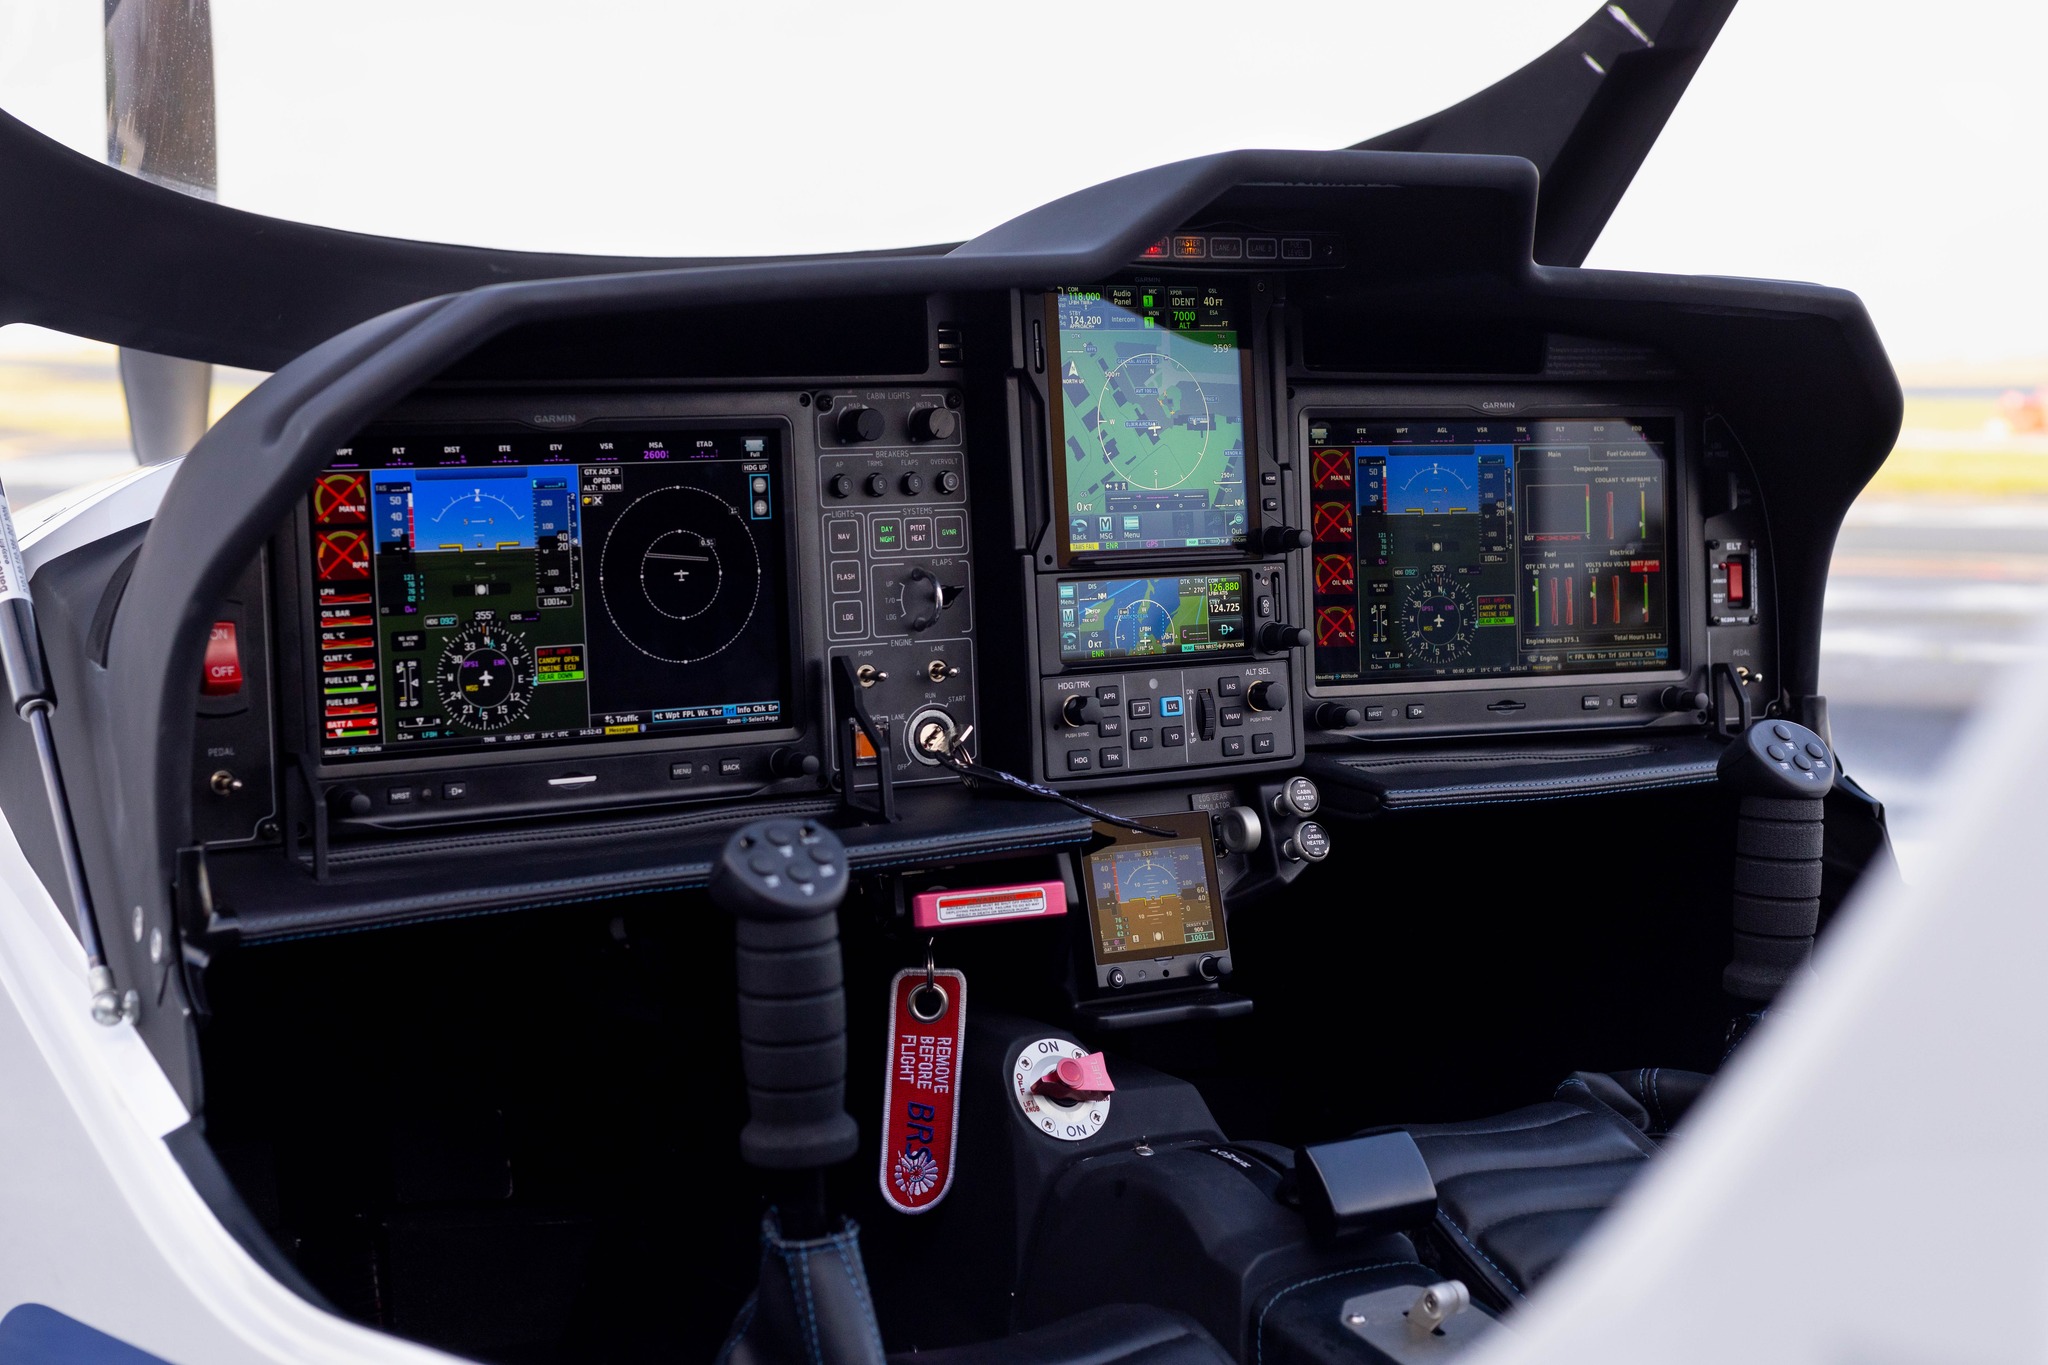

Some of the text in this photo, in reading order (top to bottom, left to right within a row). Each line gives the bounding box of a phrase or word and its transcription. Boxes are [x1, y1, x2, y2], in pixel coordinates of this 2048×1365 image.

[1172, 298, 1195, 306] IDENT
[1070, 316, 1101, 325] 124.200
[1173, 312, 1195, 321] 7000
[534, 415, 576, 423] GARMIN
[389, 497, 401, 505] 50
[391, 513, 402, 521] 40
[1209, 582, 1239, 592] 126.880
[1210, 604, 1240, 613] 124.725
[211, 629, 227, 640] ON
[212, 666, 235, 678] OFF
[1058, 681, 1090, 690] HDG/TRK
[665, 712, 680, 720] Wpt
[737, 705, 751, 713] Info
[753, 704, 766, 712] Chk
[616, 714, 639, 723] Traffic
[208, 748, 234, 757] PEDAL
[1038, 1041, 1059, 1053] ON
[900, 1034, 917, 1084] FLIGHT
[917, 1035, 935, 1089] BEFORE
[934, 1037, 952, 1094] REMOVE
[1092, 1059, 1104, 1086] FUEL
[1016, 1073, 1025, 1096] OFF
[907, 1101, 935, 1164] BRS
[1067, 1124, 1086, 1137] ON
